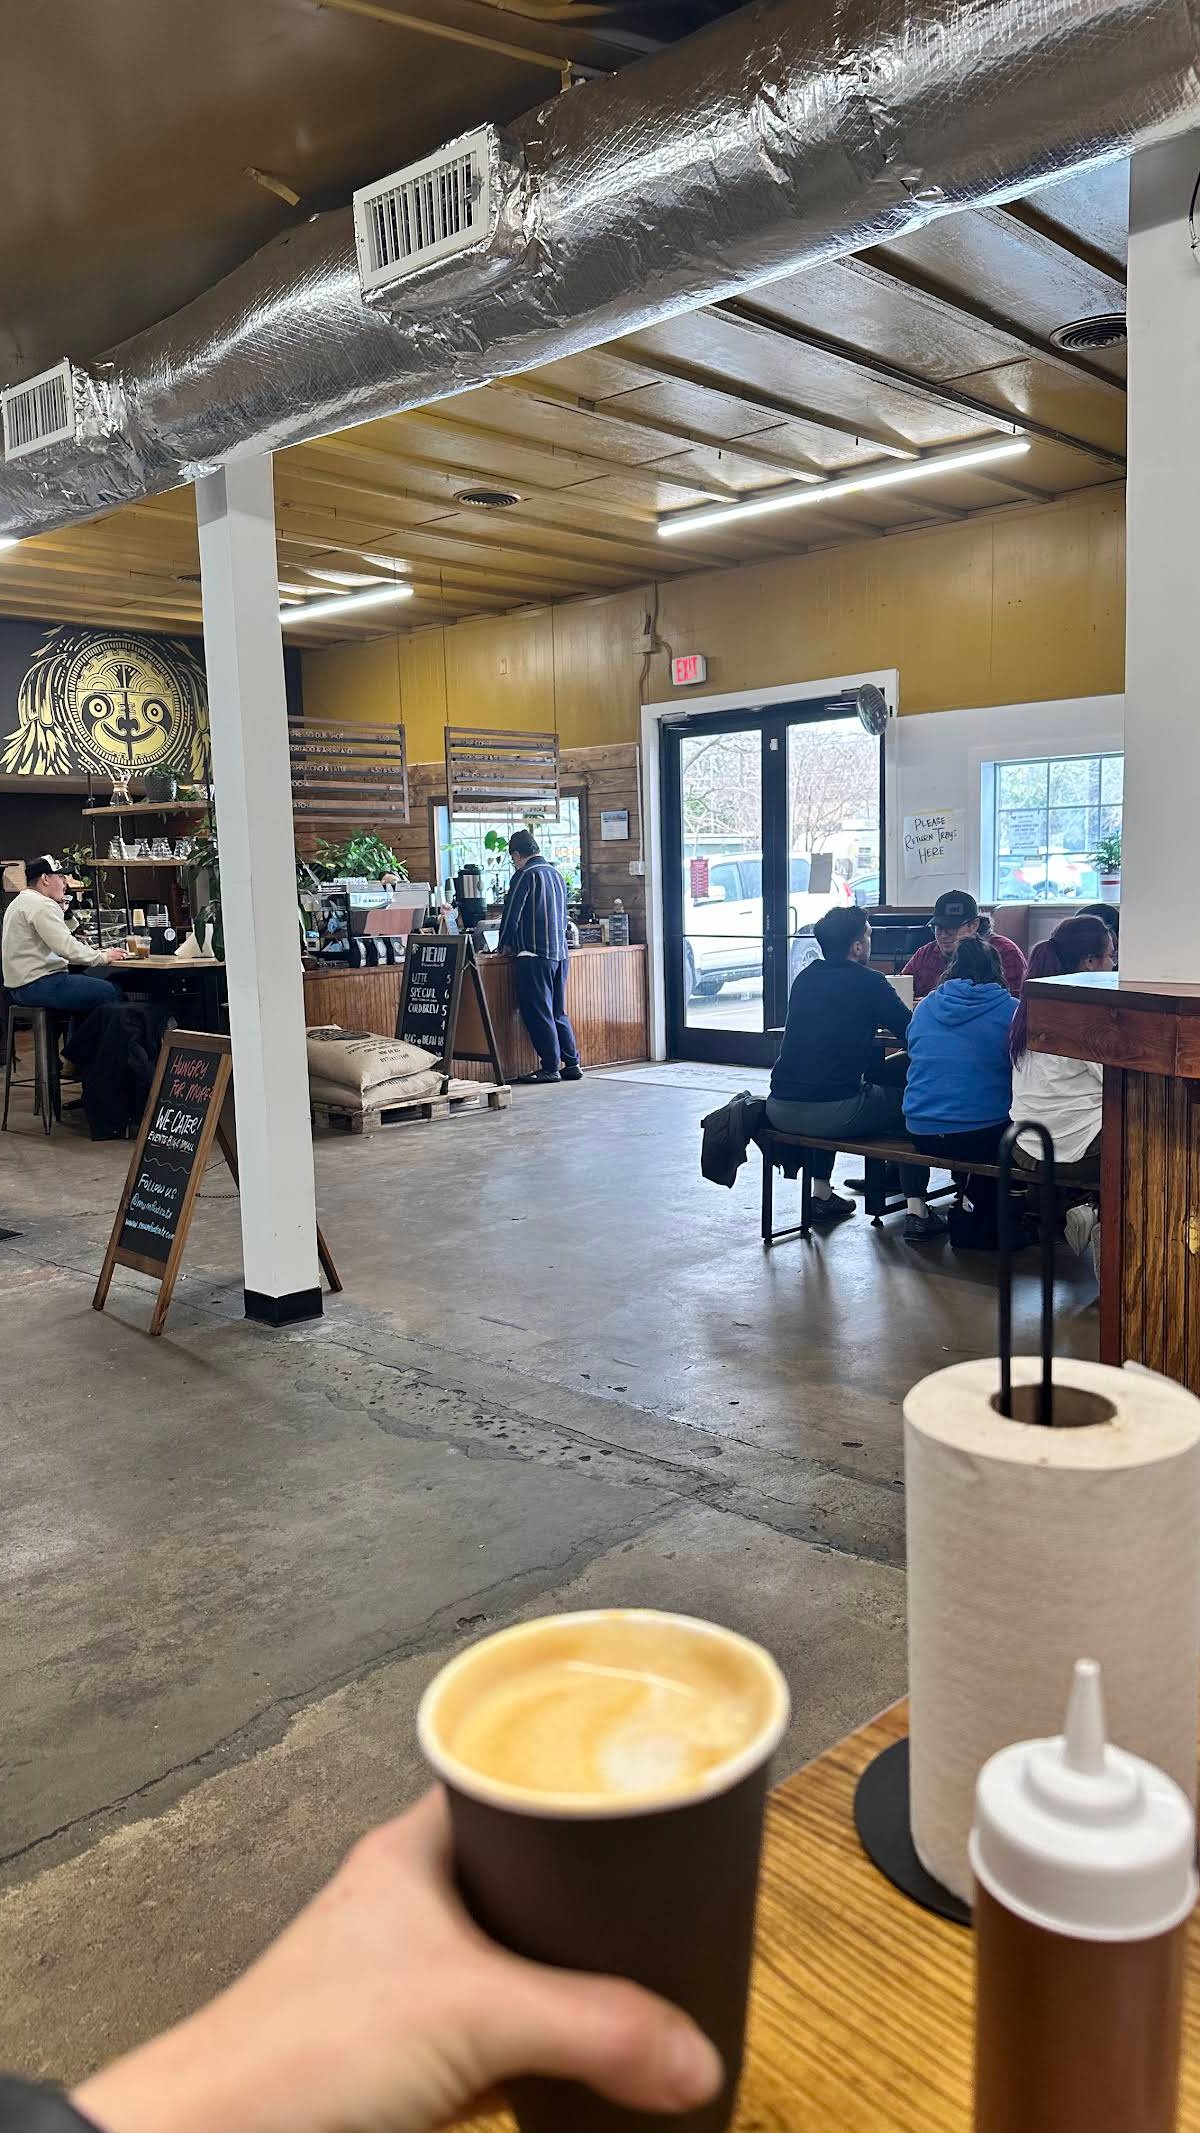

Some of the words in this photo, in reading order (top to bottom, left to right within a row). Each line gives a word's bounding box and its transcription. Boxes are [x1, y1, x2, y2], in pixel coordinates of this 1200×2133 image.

[676, 656, 697, 682] EXIT
[290, 730, 314, 738] PRESSO
[290, 745, 315, 753] ORTADO
[291, 764, 322, 772] APPUCCINO
[914, 817, 946, 831] PLEASE
[918, 846, 945, 865] HERE
[421, 946, 447, 962] MENU
[446, 974, 452, 984] 5
[410, 987, 436, 998] SPECIAL
[444, 989, 450, 999] 6
[441, 1004, 448, 1016] 5
[440, 1020, 446, 1031] 4
[170, 1054, 210, 1079] HUNGRY
[169, 1079, 186, 1099] FOR
[155, 1106, 175, 1131] WE
[170, 1110, 204, 1136] CATER!
[148, 1130, 168, 1144] EVENTS
